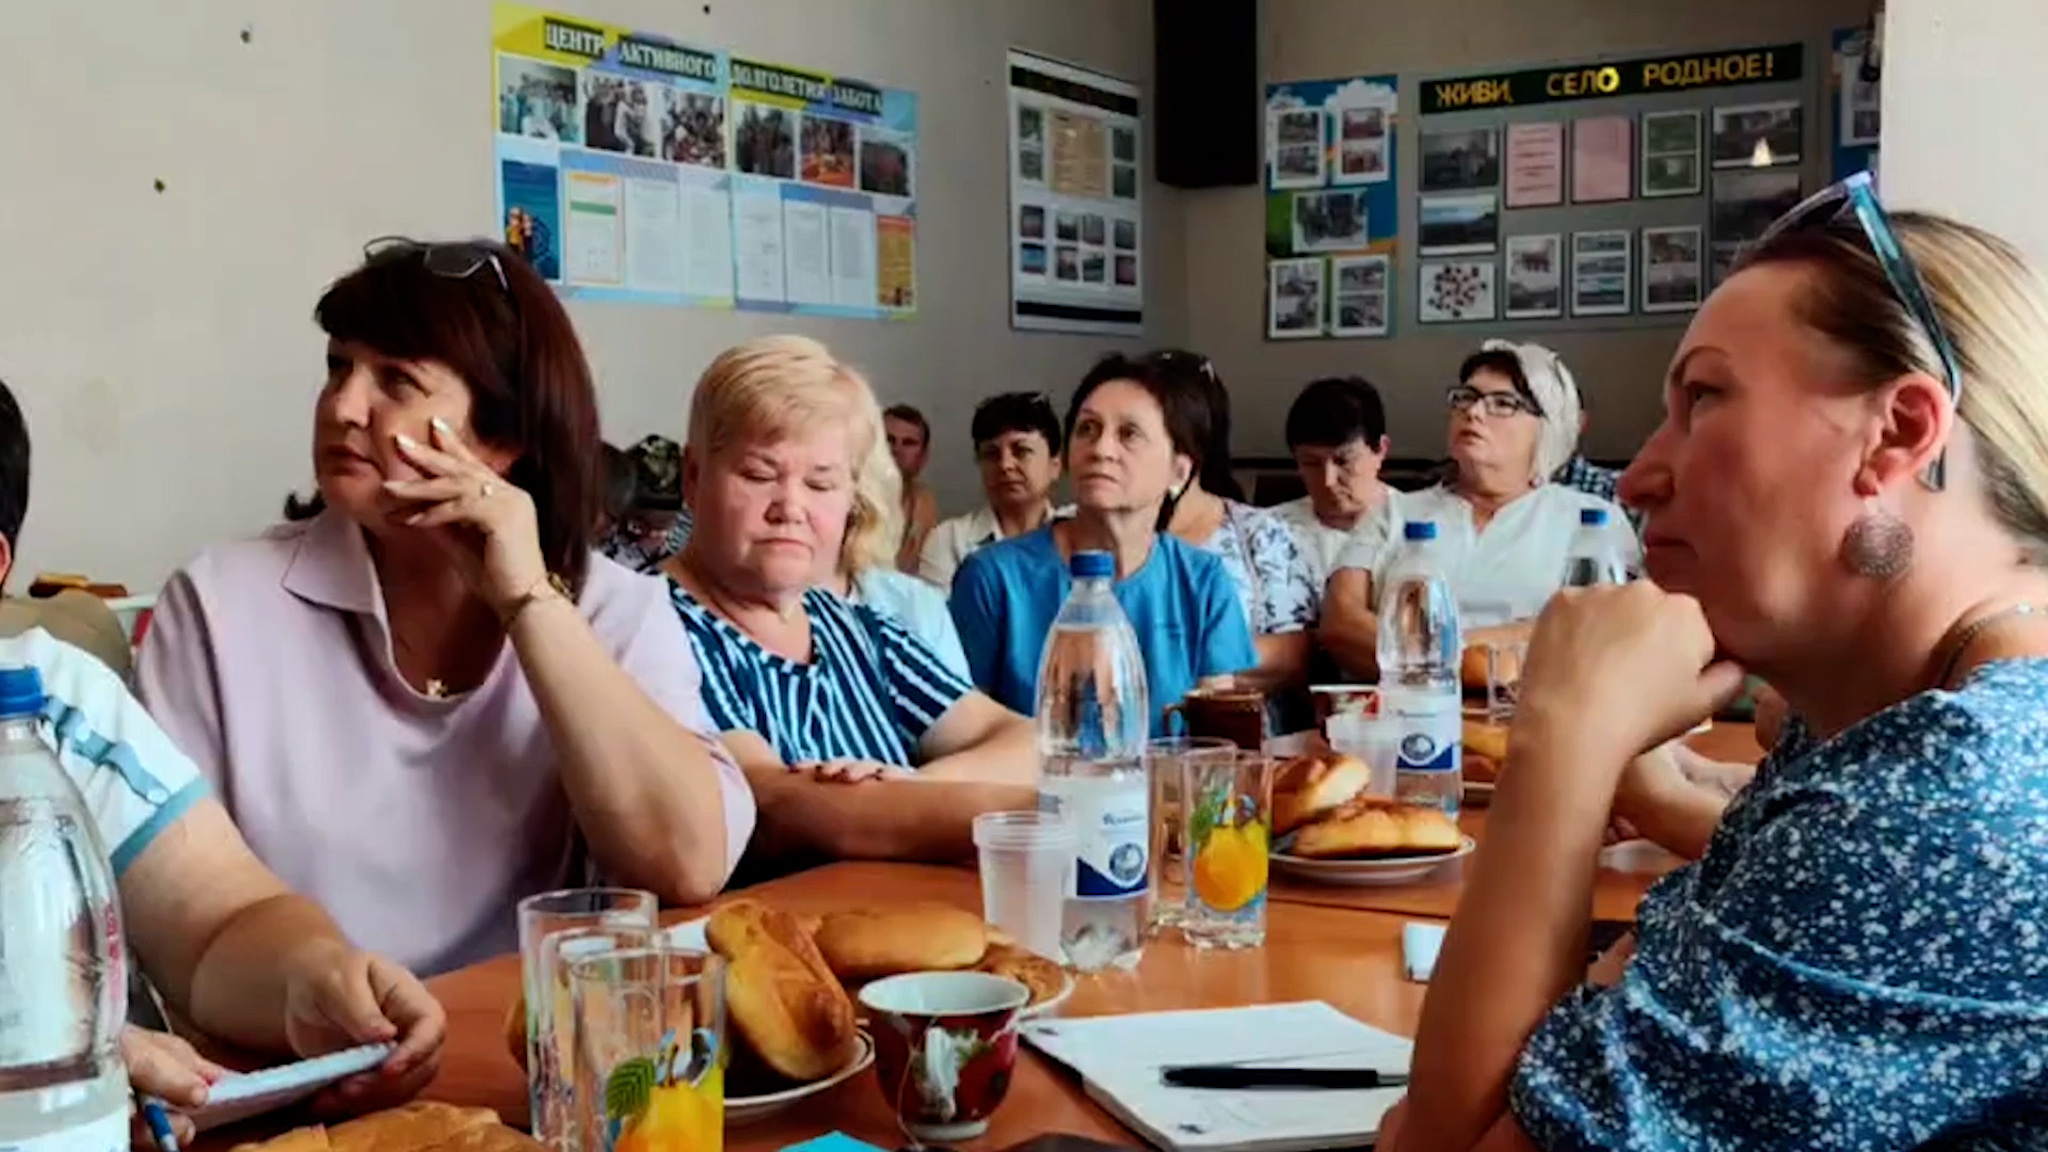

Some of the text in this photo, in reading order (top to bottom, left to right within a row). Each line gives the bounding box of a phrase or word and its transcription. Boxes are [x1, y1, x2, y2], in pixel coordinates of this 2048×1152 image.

[546, 22, 881, 113] ЦЕНТР АКТИВНОГО ДОЛГОЛЕТИЯ ЗАБОТА
[1546, 66, 1620, 97] СЕЛО
[1642, 52, 1774, 87] РОДНОЕ!
